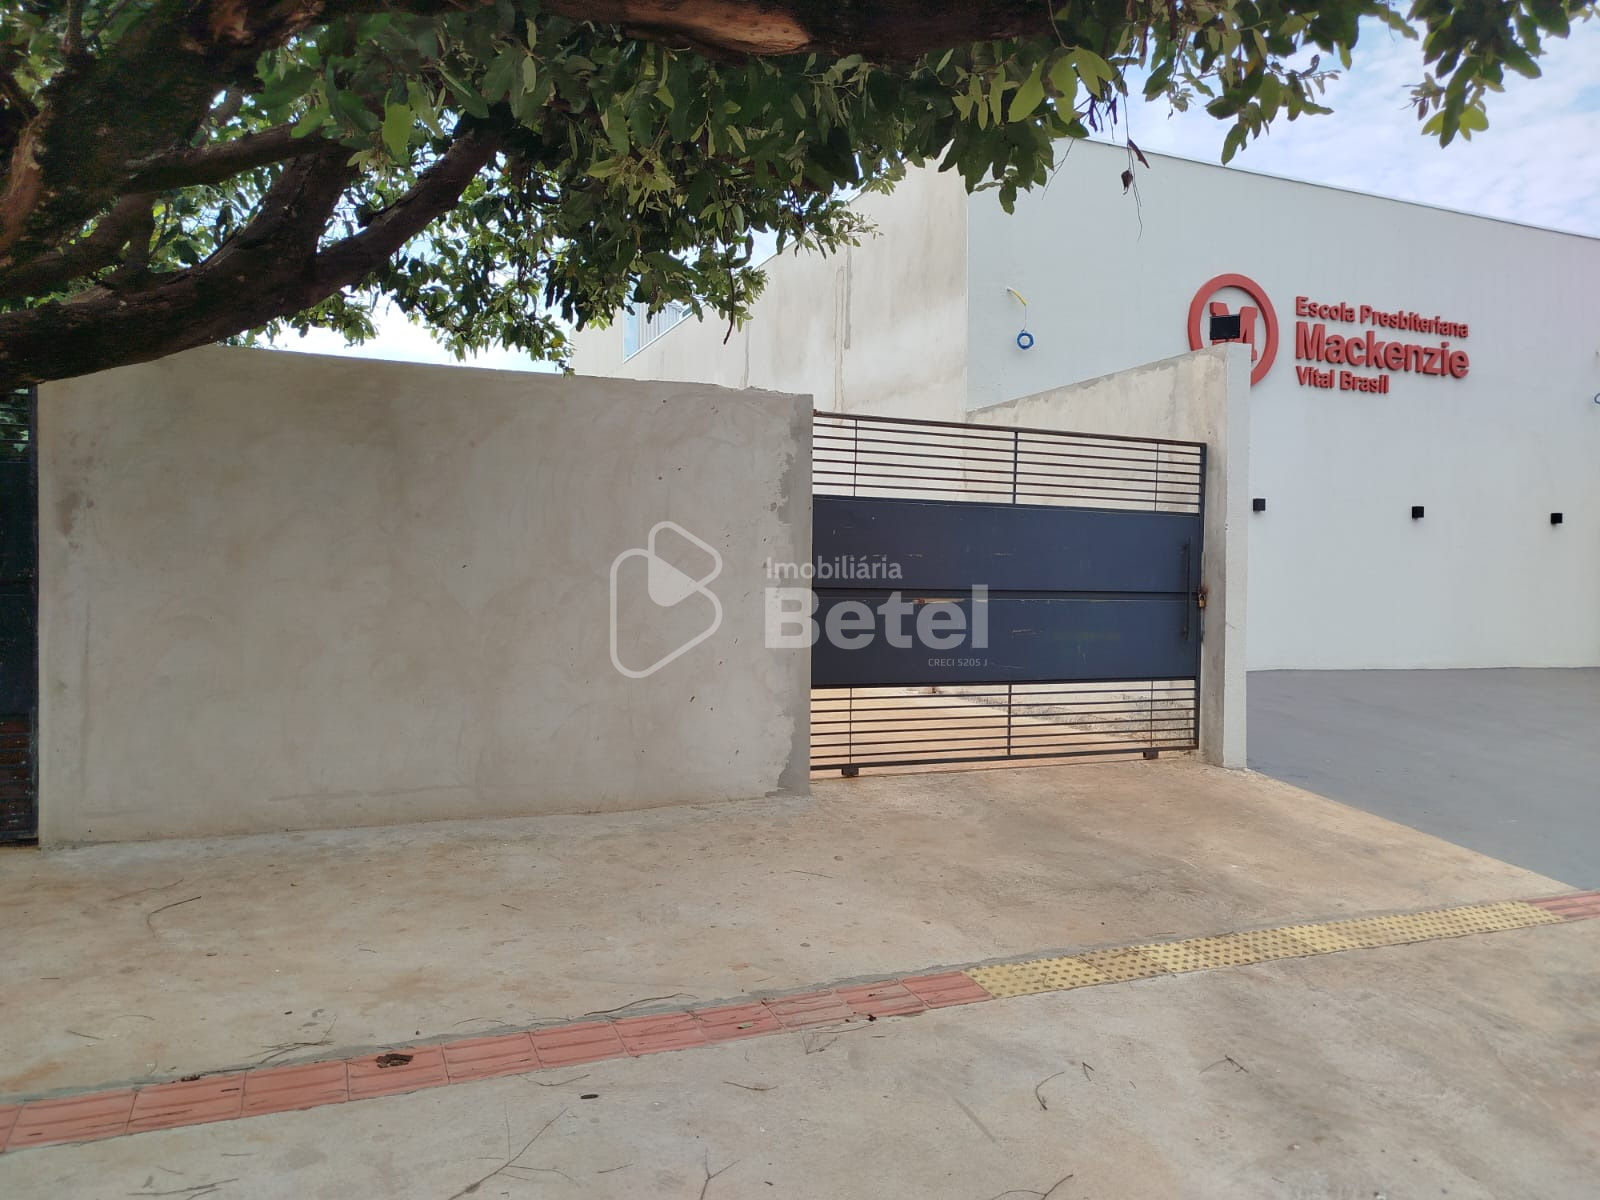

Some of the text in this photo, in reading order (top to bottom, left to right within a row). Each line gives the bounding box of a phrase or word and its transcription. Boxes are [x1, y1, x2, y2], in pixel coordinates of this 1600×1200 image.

[1296, 296, 1469, 338] Escola Presbiteriana
[1296, 321, 1470, 378] Mackenzie
[1296, 365, 1389, 394] Vital Brasil
